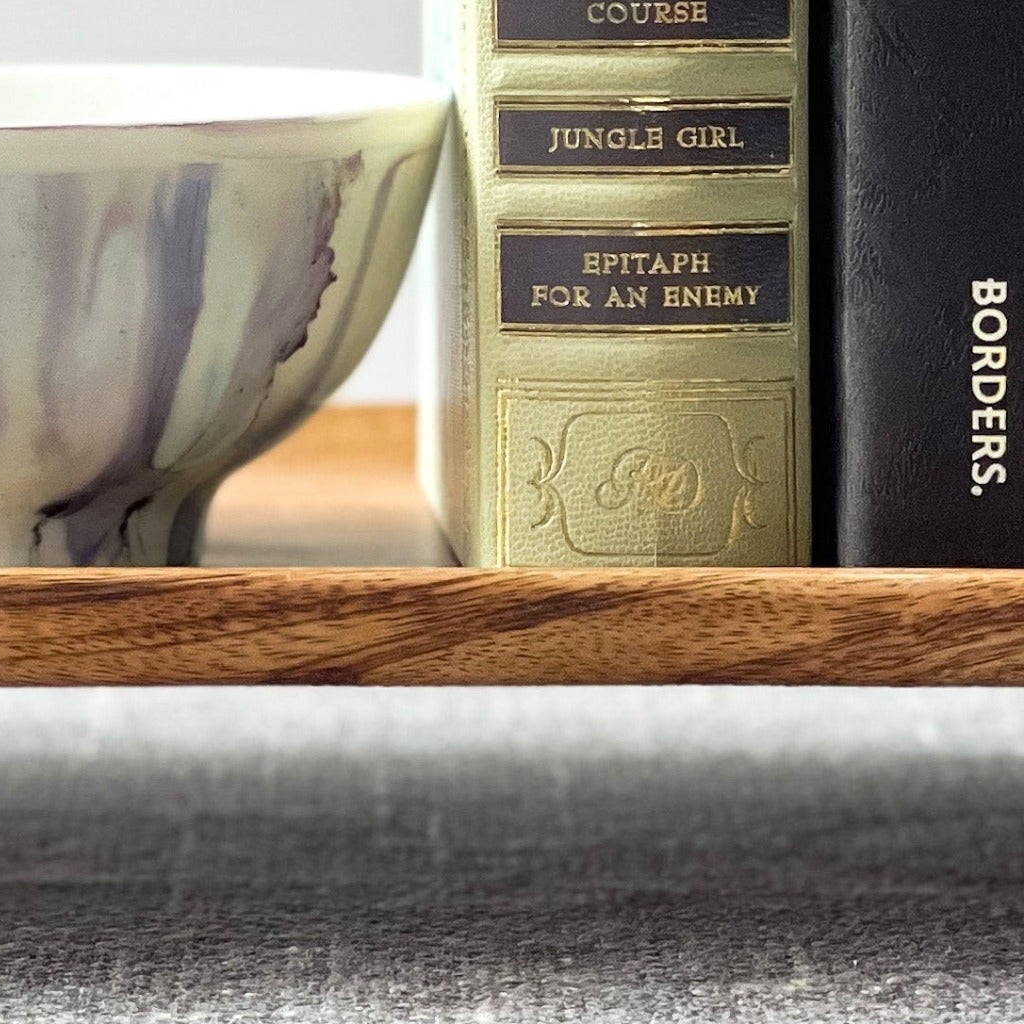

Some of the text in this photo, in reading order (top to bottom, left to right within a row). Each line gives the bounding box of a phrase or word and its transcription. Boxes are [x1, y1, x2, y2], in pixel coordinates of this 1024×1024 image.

[586, 1, 709, 24] COURSE
[548, 126, 744, 153] JUNGLE GIRL
[581, 252, 710, 276] EPITAPH
[531, 285, 761, 309] FOR AN ENEMY
